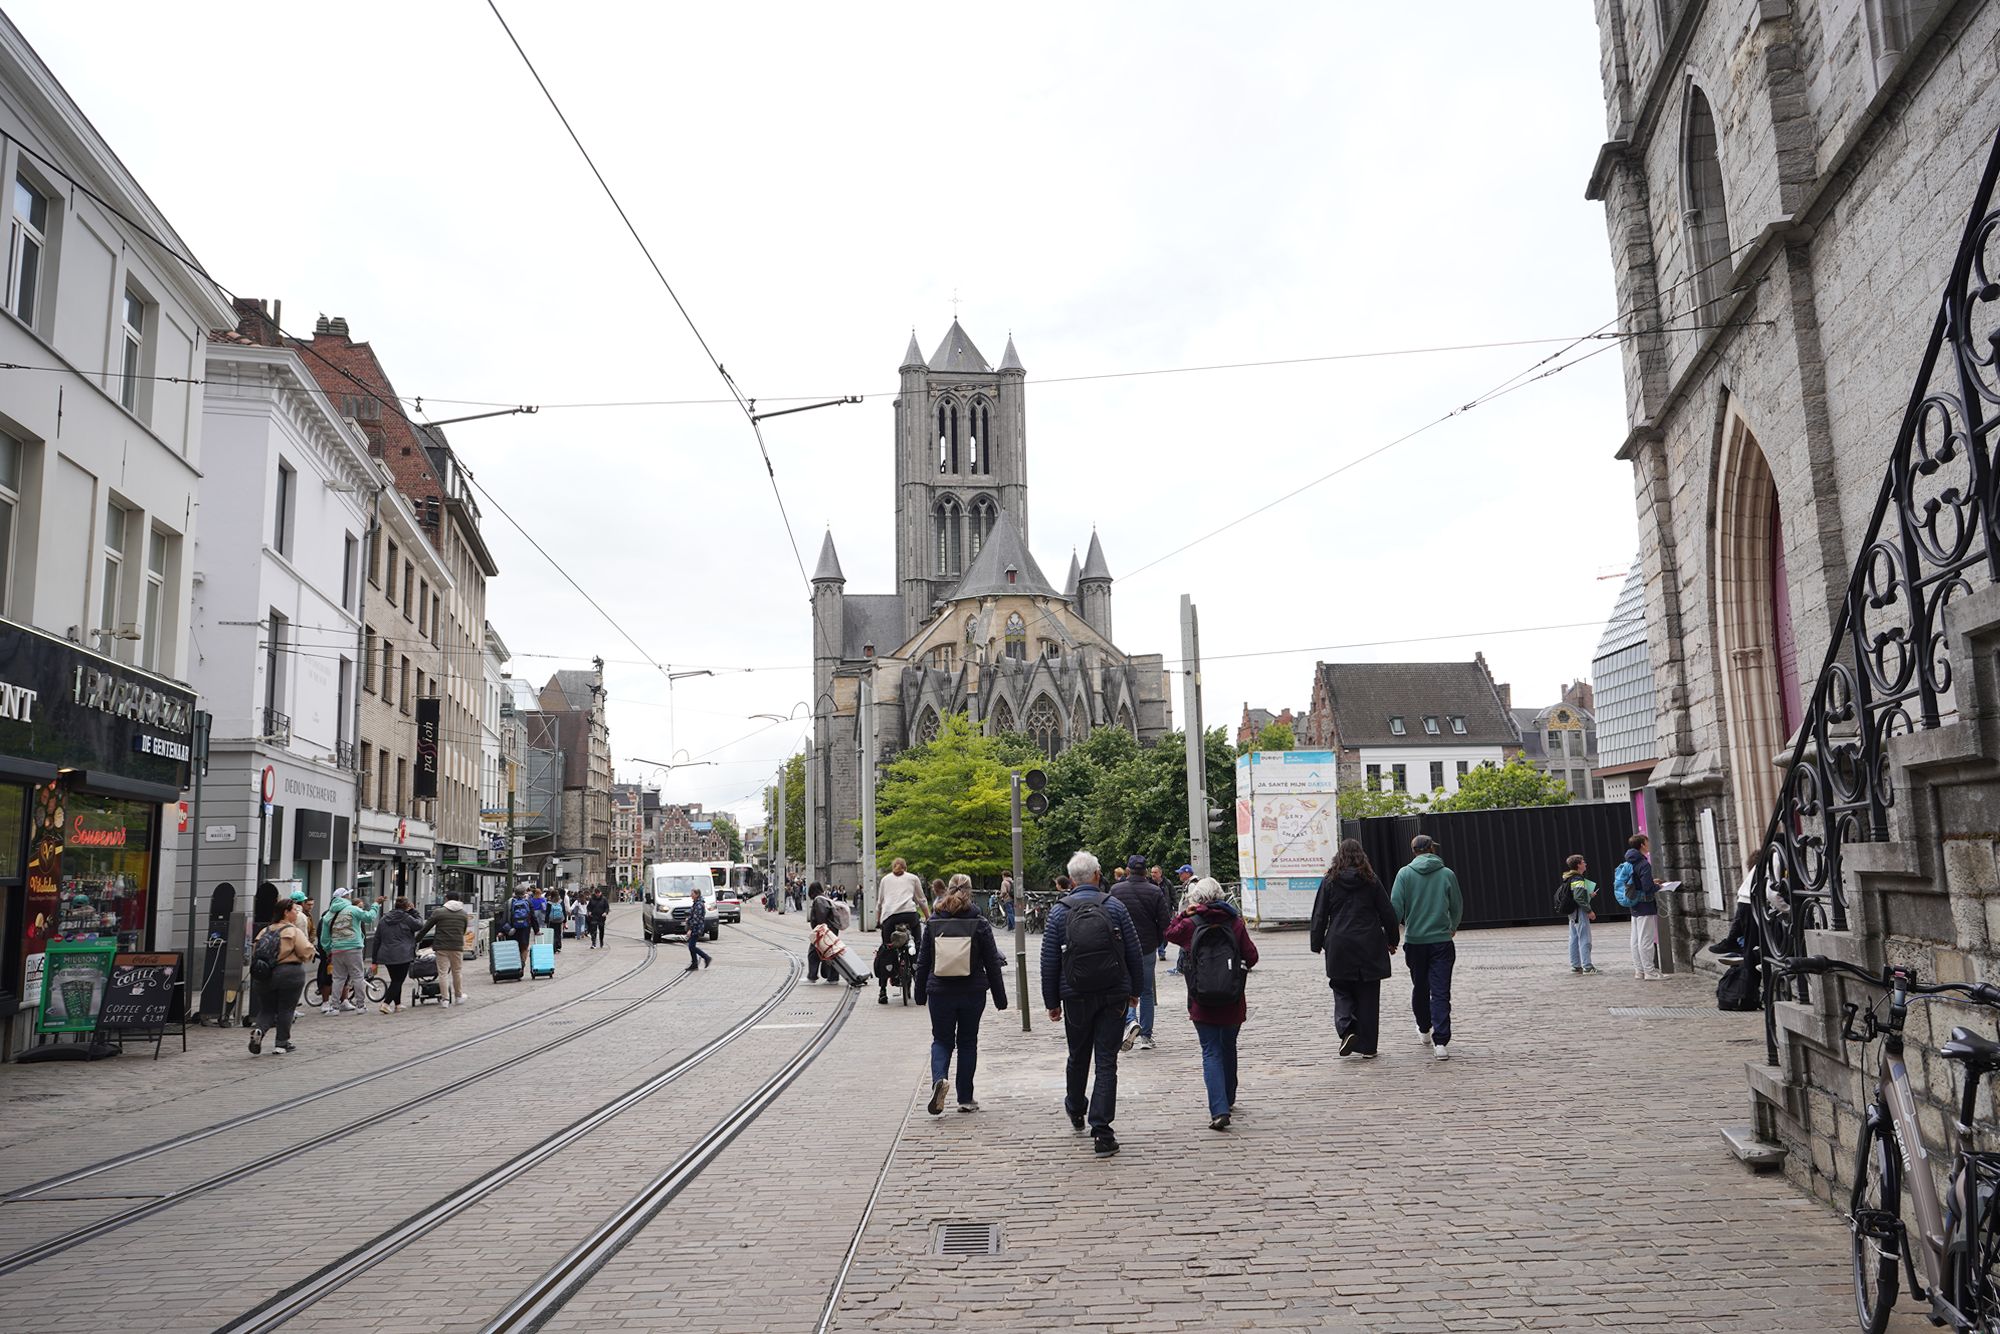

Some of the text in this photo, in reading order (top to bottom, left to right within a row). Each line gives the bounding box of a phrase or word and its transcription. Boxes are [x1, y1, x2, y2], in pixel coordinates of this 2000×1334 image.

[141, 734, 190, 762] DE GENTENAAR
[71, 815, 127, 846] Souvenirs
[113, 969, 154, 987] COFFEE
[103, 1015, 134, 1023] LATTE
[106, 1004, 141, 1013] COFFEE
[1893, 1119, 1911, 1172] Gazelle
